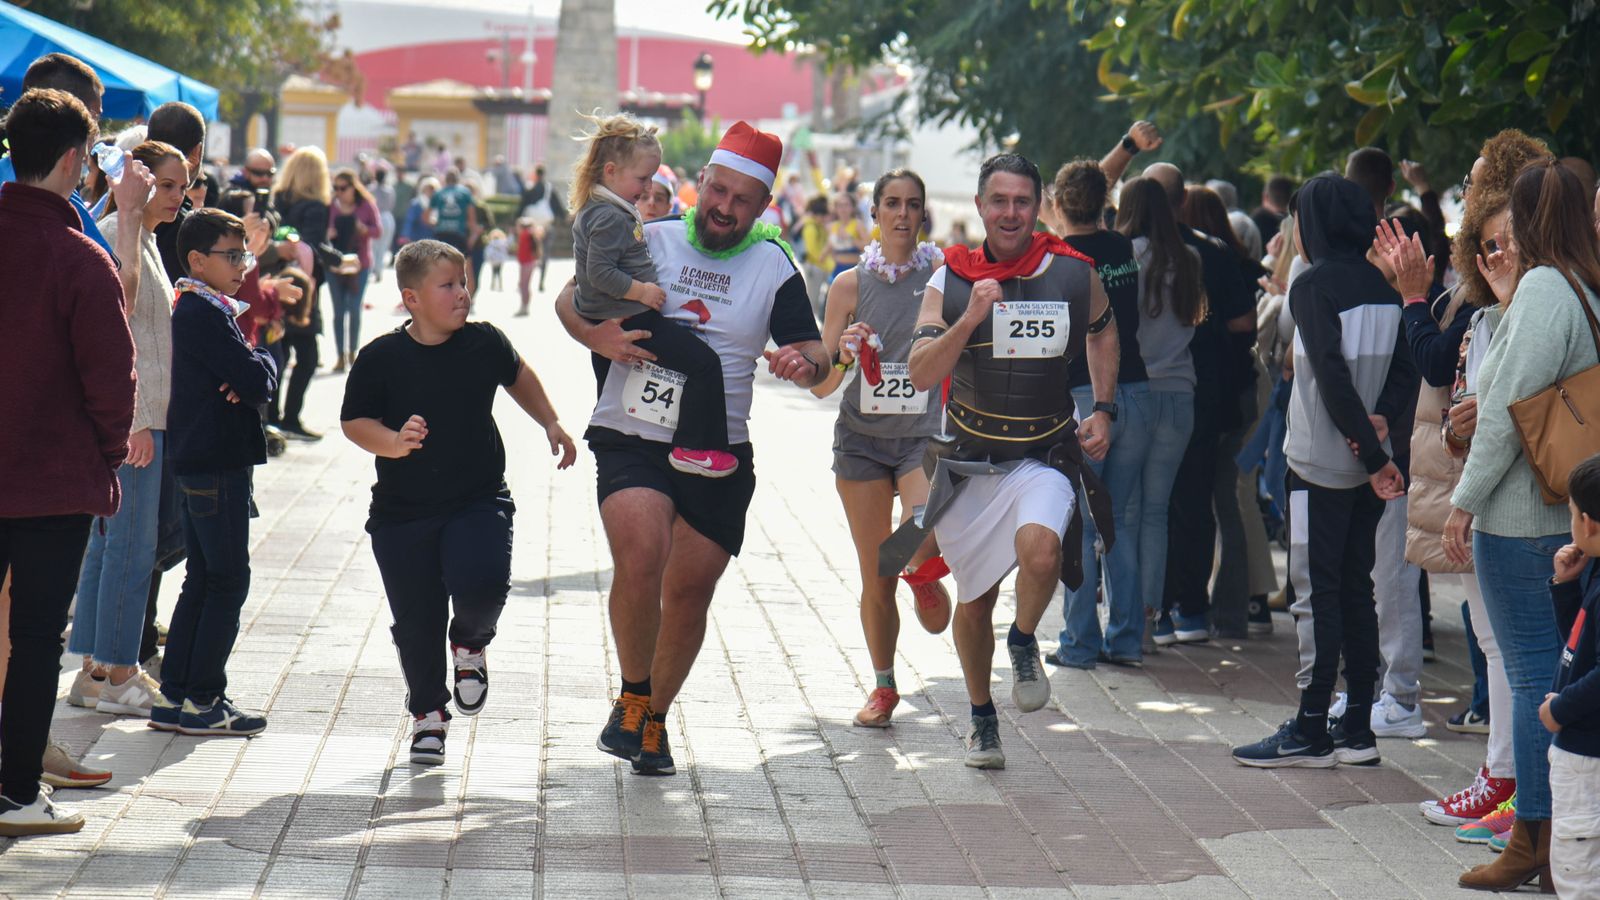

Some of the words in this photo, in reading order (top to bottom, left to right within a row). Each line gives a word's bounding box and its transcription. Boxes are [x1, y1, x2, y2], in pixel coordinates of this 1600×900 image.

[678, 276, 693, 287] SAN
[693, 279, 730, 295] SILVESTRE
[681, 265, 689, 276] II
[689, 267, 731, 286] CARRERA
[669, 283, 691, 296] TARIFA
[720, 298, 733, 306] 2023
[1009, 320, 1056, 339] 255
[650, 365, 665, 374] SAN
[640, 380, 675, 409] 54
[873, 378, 916, 399] 225
